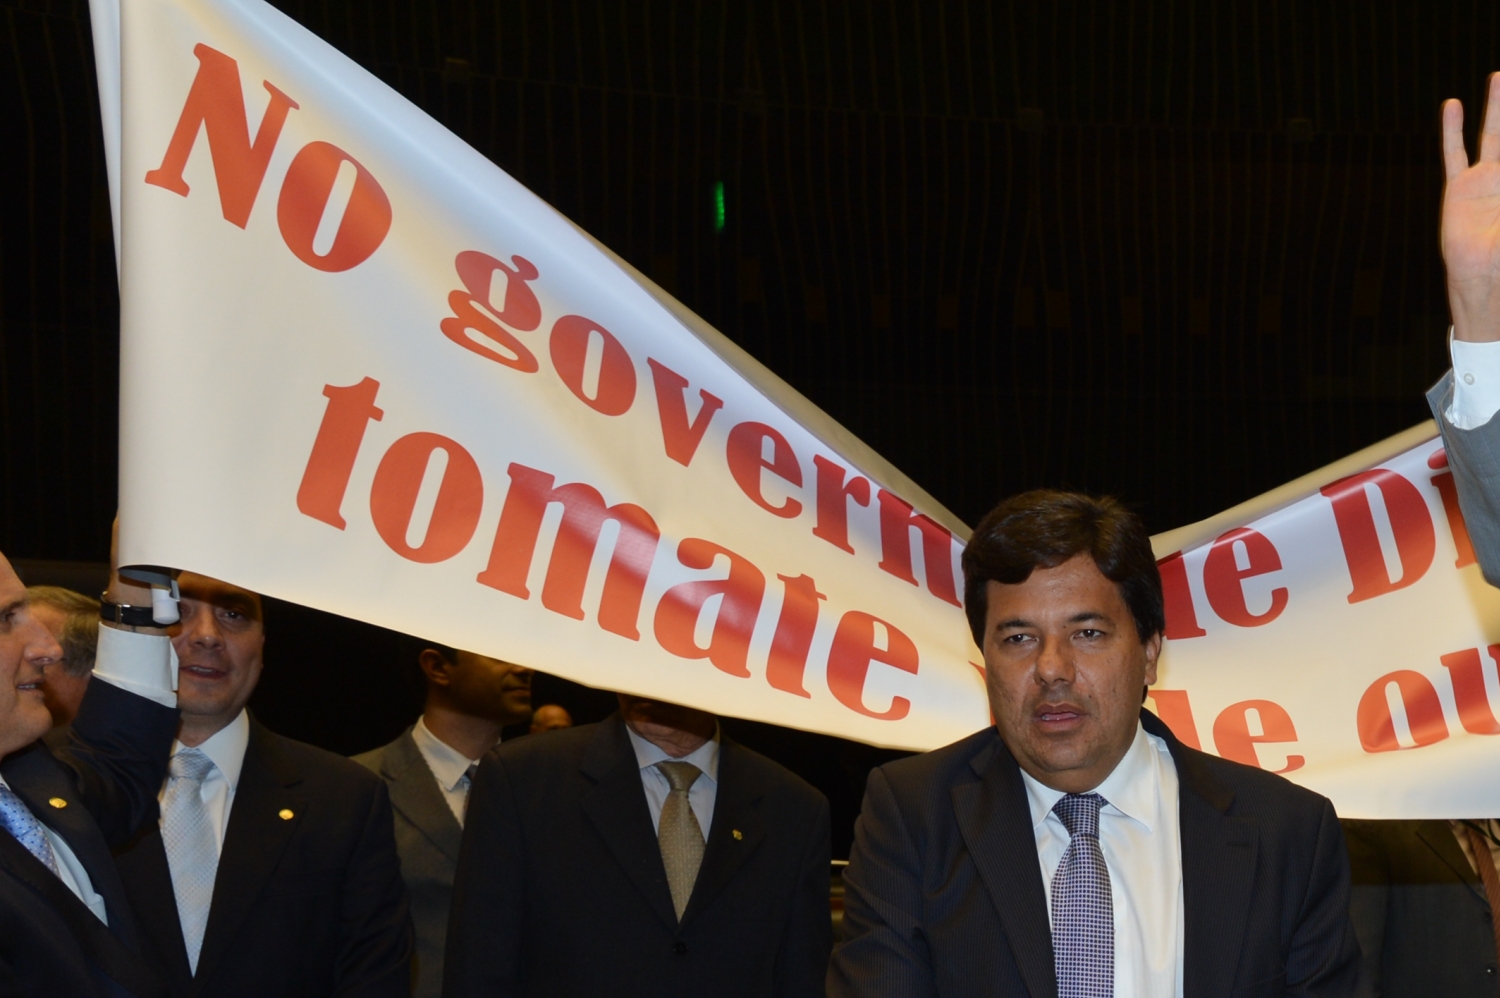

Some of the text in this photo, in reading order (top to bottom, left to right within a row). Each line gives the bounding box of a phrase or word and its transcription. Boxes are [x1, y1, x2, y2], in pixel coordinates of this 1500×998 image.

[146, 44, 392, 272] NO
[441, 251, 962, 607] govern
[297, 377, 919, 721] tomate
